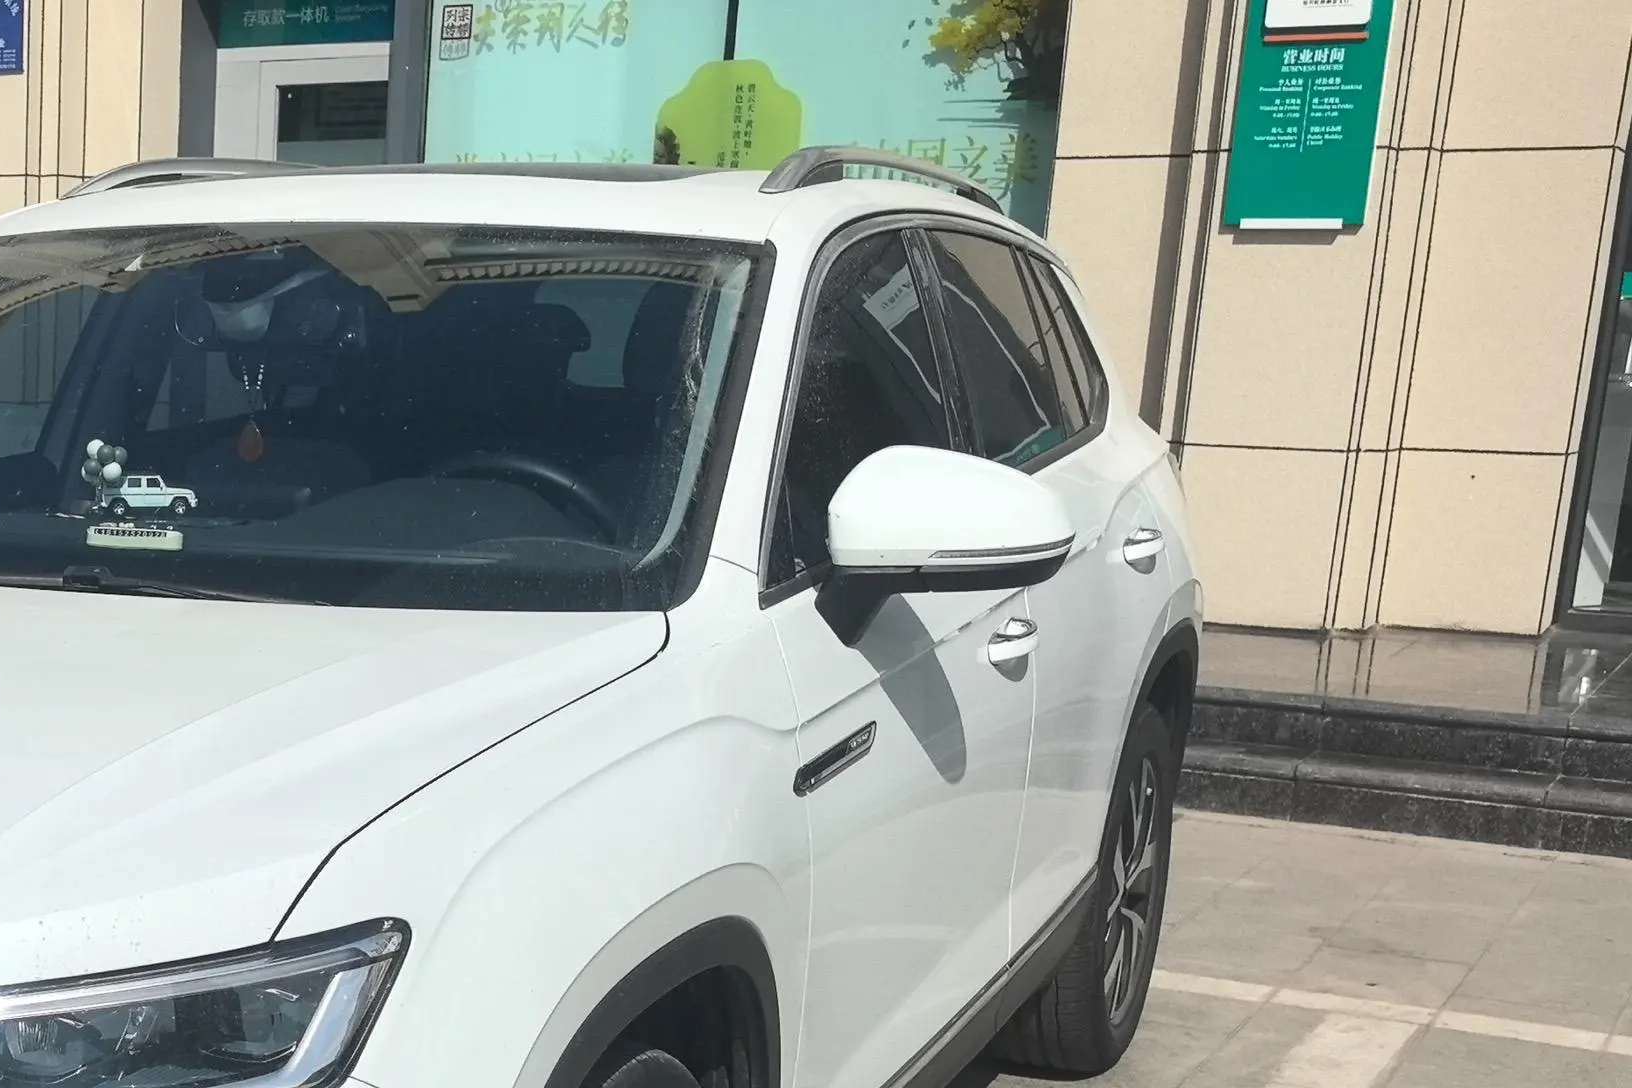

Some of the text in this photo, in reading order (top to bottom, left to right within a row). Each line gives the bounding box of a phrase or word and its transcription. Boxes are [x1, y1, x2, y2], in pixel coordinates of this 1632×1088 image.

[243, 6, 330, 27] 存取款一体机
[1283, 47, 1346, 65] 营业时间
[1281, 64, 1316, 73] BUSINESS
